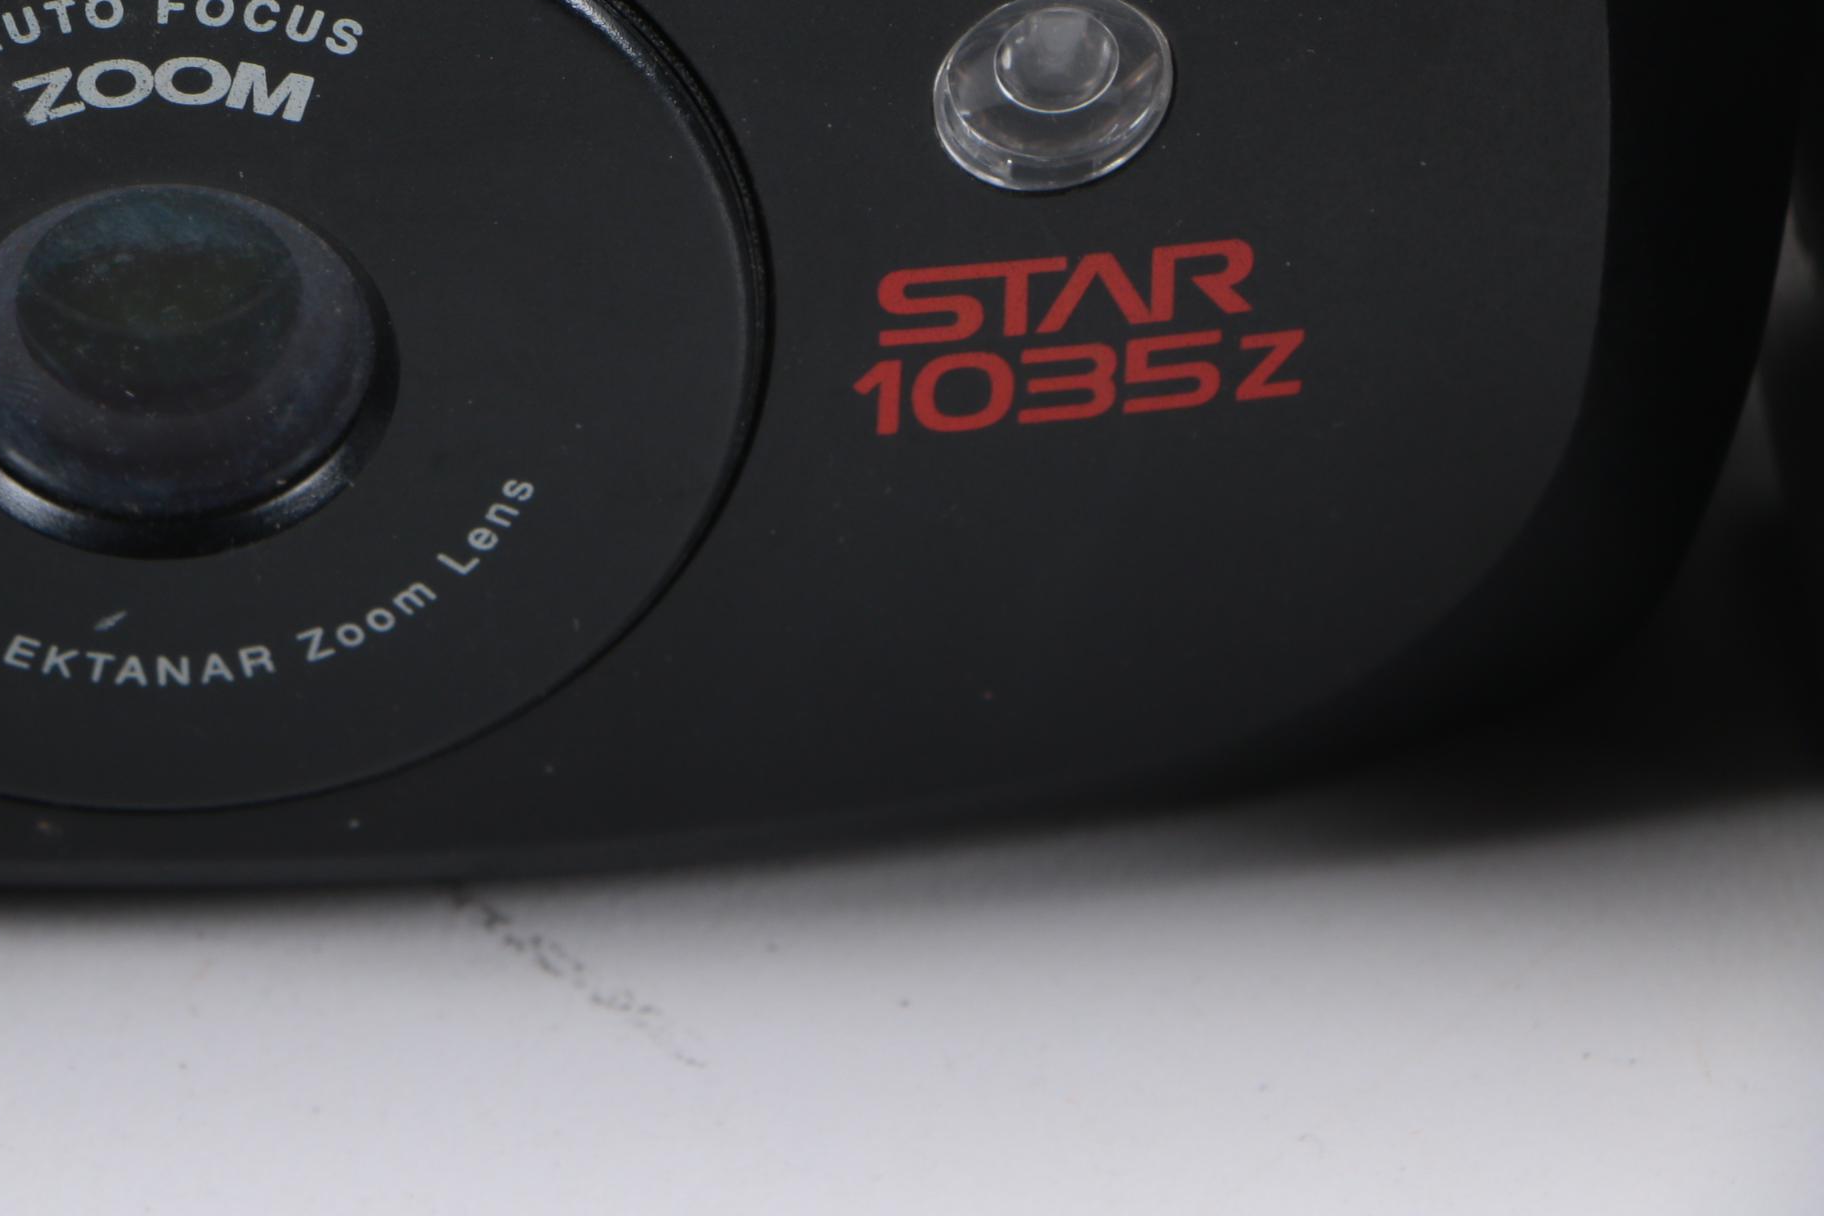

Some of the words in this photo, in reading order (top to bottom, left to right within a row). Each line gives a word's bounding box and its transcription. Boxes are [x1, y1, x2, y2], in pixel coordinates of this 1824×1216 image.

[12, 55, 316, 126] ZOOM
[876, 237, 1255, 347] STAR
[3, 634, 275, 686] EKTANAR
[296, 583, 438, 662] Zoom
[436, 478, 535, 578] Lens
